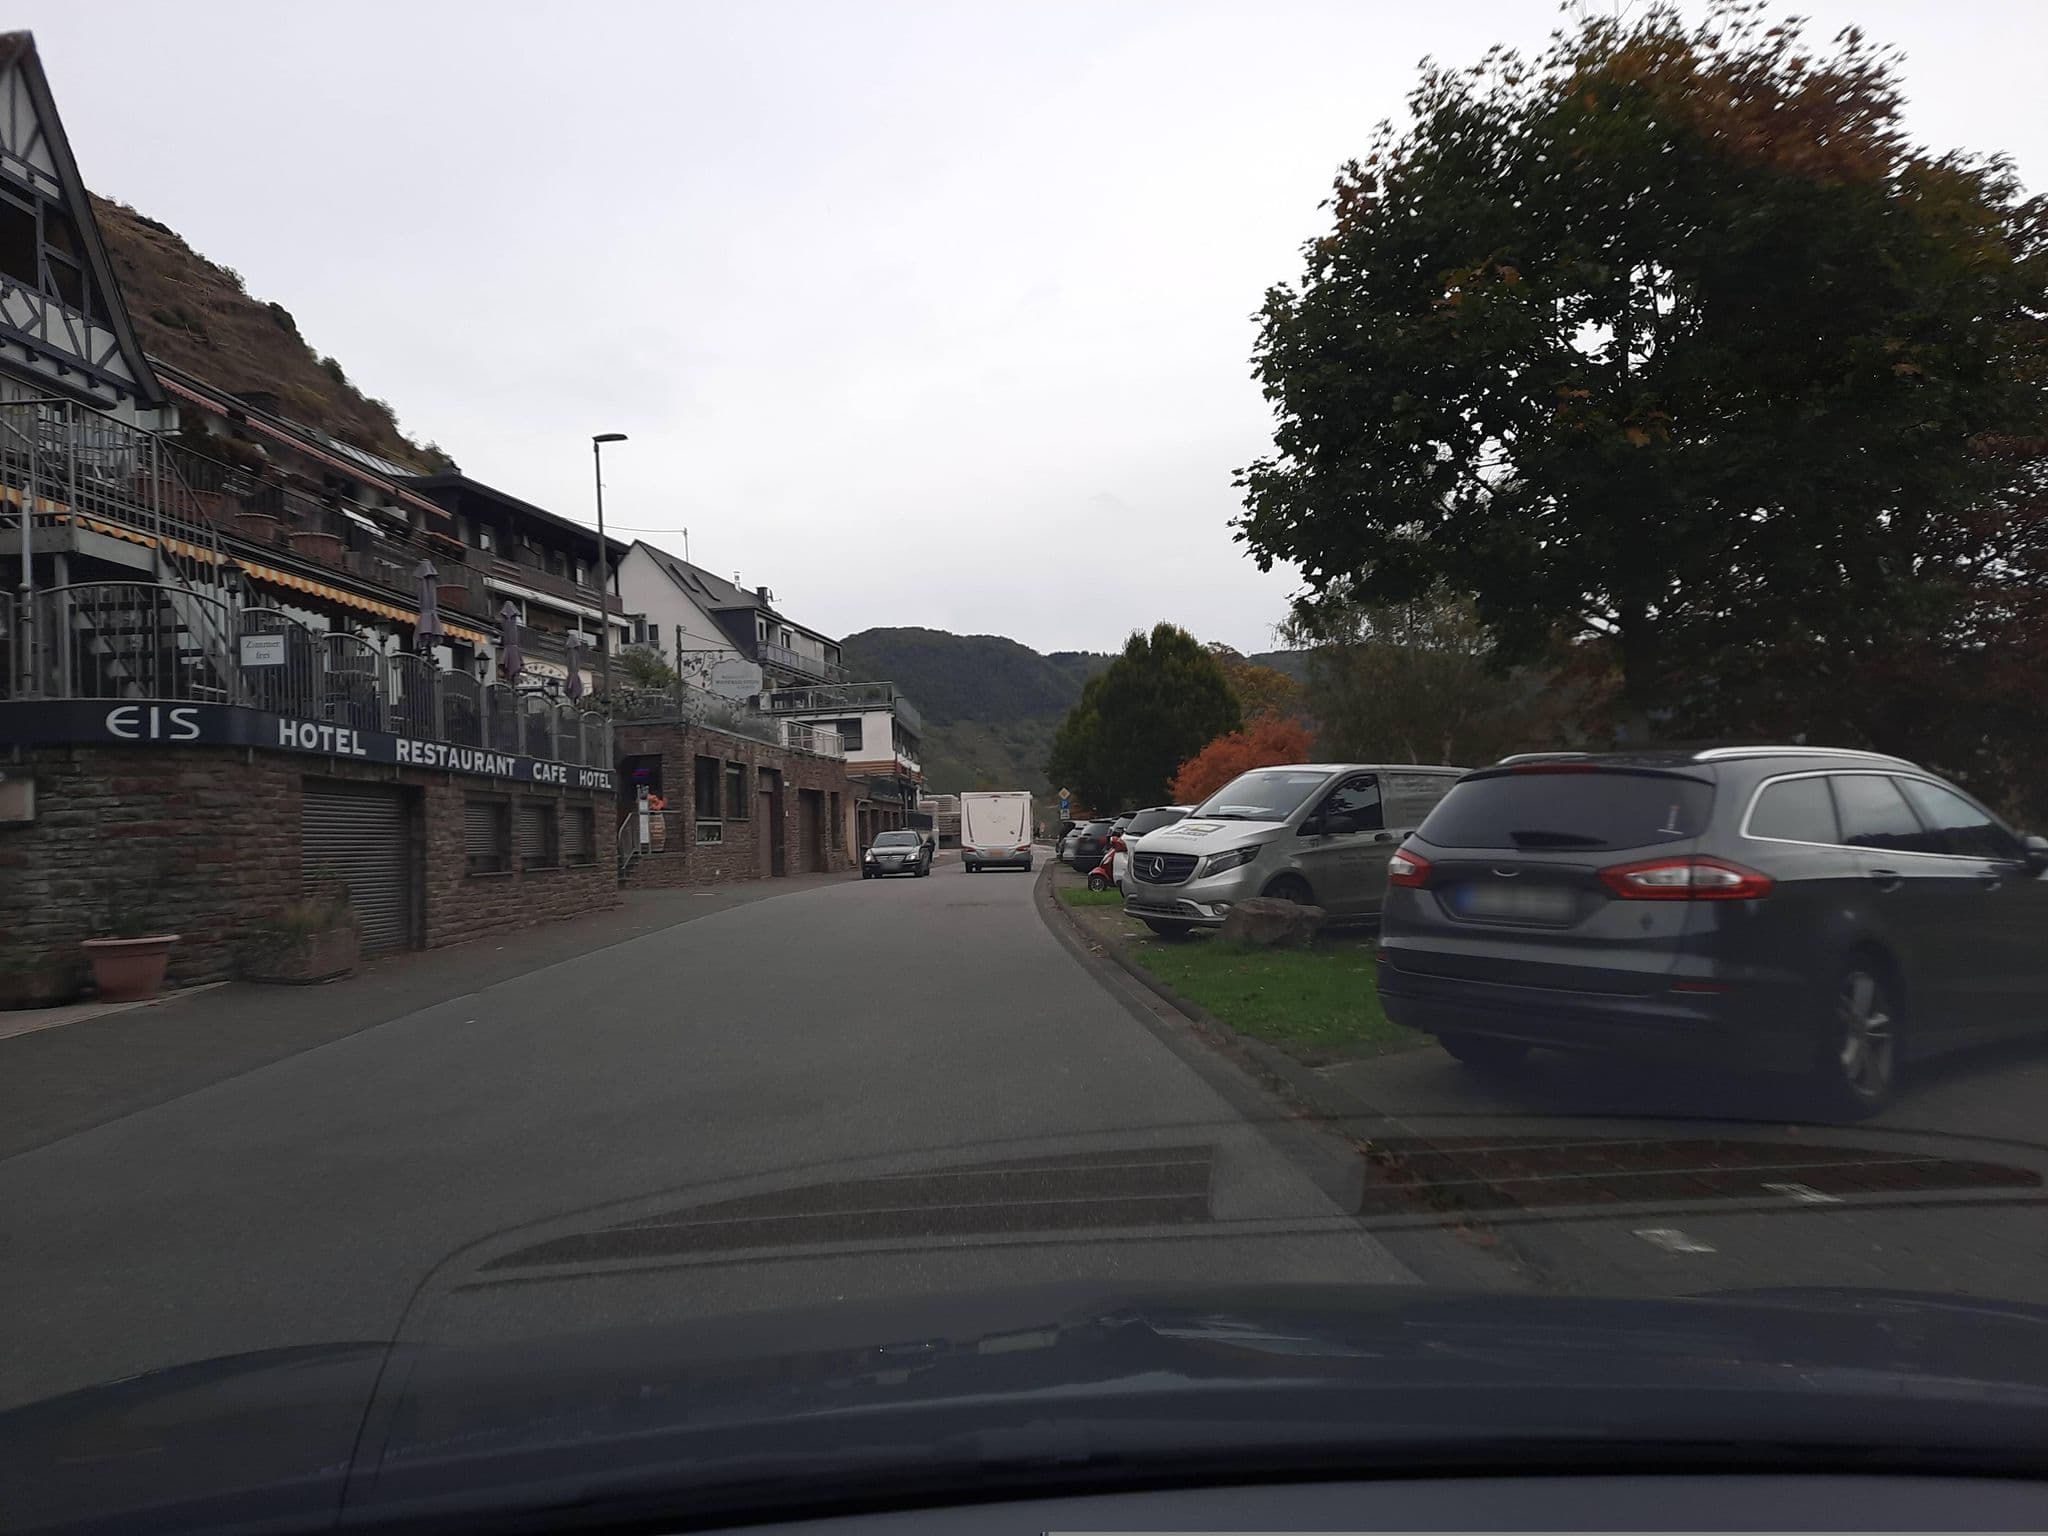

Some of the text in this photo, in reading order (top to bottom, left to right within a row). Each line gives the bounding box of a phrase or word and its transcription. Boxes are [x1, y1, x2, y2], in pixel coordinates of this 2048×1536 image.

[105, 705, 201, 741] EIS
[278, 718, 612, 789] HOTEL RESTAURANT CAFE HOTEL
